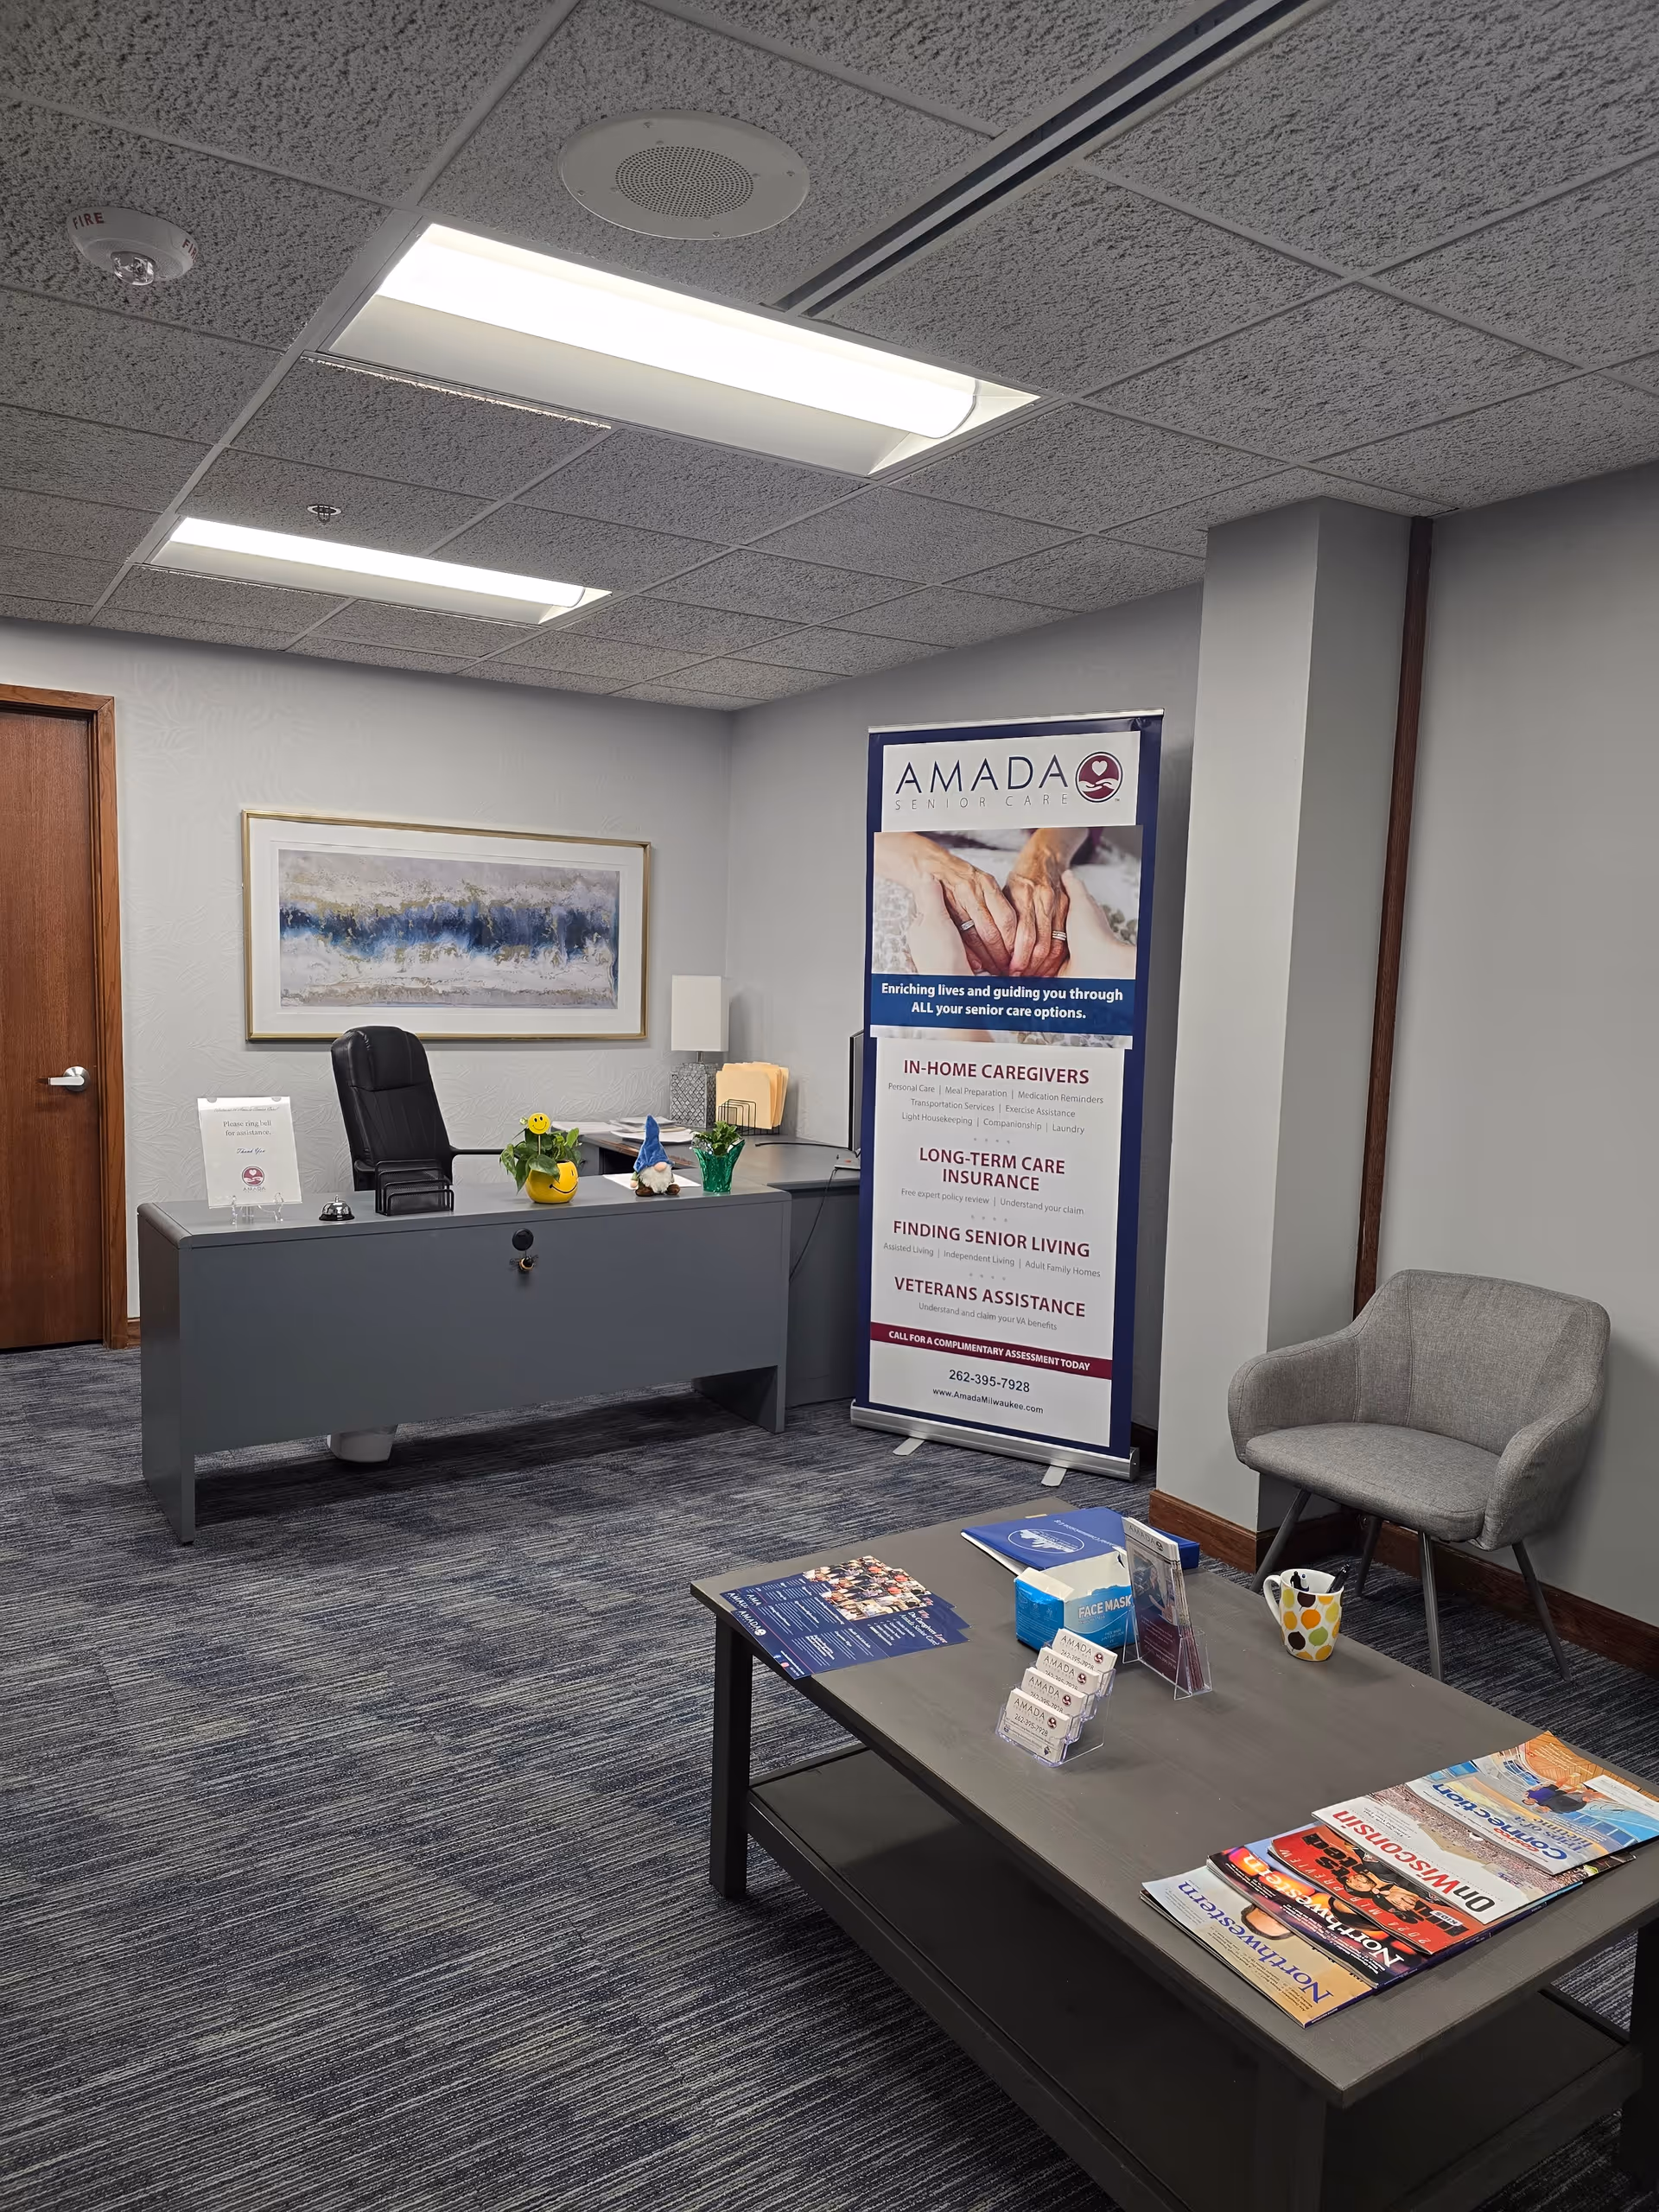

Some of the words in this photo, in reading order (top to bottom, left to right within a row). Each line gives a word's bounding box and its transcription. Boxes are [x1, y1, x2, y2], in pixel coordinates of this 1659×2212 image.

[73, 213, 105, 230] FIRE
[895, 754, 1068, 794] AMADA
[895, 796, 986, 810] SENIOR
[1005, 793, 1068, 807] CARE
[881, 982, 935, 999] Enriching
[938, 984, 964, 997] lives
[967, 984, 990, 998] and
[993, 985, 1039, 1001] guiding
[1043, 989, 1066, 1001] you
[1069, 987, 1123, 1002] through
[912, 1001, 933, 1014] ALL
[936, 1004, 963, 1016] your
[965, 1003, 1004, 1016] senior
[1006, 1006, 1032, 1017] care
[1034, 1005, 1086, 1020] options.
[904, 1059, 977, 1077] IN-HOME
[982, 1064, 1090, 1084] CAREGIVERS
[888, 1083, 918, 1092] Personal
[918, 1084, 935, 1093] Care
[945, 1086, 963, 1095] Meal
[964, 1087, 1007, 1099] Preparation
[1018, 1091, 1058, 1102] Medication
[1060, 1093, 1104, 1104] Reminders
[911, 1098, 963, 1111] Transportation
[964, 1102, 995, 1112] Services
[1005, 1104, 1035, 1115] Exercise
[1036, 1107, 1076, 1118] Assistance
[901, 1112, 920, 1122] Light
[921, 1114, 973, 1127] Housekeeping
[983, 1118, 1042, 1131] Companionship
[1052, 1124, 1085, 1135] Laundry
[919, 1147, 1017, 1169] LONG-TERM
[1021, 1156, 1065, 1174] CARE
[943, 1168, 1039, 1192] INSURANCE
[901, 1188, 916, 1197] Free
[918, 1190, 941, 1201] expert
[942, 1192, 963, 1204] policy
[964, 1194, 989, 1205] review
[1000, 1198, 1043, 1211] Understand
[1044, 1205, 1061, 1214] your
[1063, 1205, 1084, 1215] claim
[893, 1220, 961, 1242] FINDING
[964, 1229, 1027, 1249] SENIOR
[1031, 1236, 1090, 1258] LIVING
[883, 1242, 912, 1254] Assisted
[912, 1245, 934, 1257] Living
[944, 1249, 991, 1263] Independent
[992, 1255, 1015, 1267] Living
[1025, 1260, 1046, 1271] Adult
[1046, 1262, 1071, 1275] Family
[1072, 1266, 1101, 1278] Homes
[894, 1276, 977, 1300] VETERANS
[982, 1288, 1086, 1318] ASSISTANCE
[918, 1301, 960, 1316] Understand
[961, 1308, 976, 1318] and
[976, 1310, 996, 1321] claim
[997, 1314, 1015, 1325] your
[1016, 1316, 1027, 1325] VA
[1027, 1317, 1058, 1331] benefits
[888, 1331, 909, 1342] CALL
[910, 1334, 925, 1344] FOR
[933, 1338, 1004, 1357] COMPLIMENTARY
[1005, 1349, 1060, 1367] ASSESSMENT
[1060, 1358, 1090, 1371] TODAY
[949, 1369, 1030, 1393] 262-395-7928
[932, 1388, 1044, 1414] www.AmadaMilwaukee.com
[1128, 1525, 1156, 1545] AMADA
[738, 1611, 761, 1630] AMADA
[1078, 1602, 1103, 1618] FACE
[1061, 1635, 1092, 1656] AMADA
[1044, 1656, 1076, 1676] AMADA
[1028, 1676, 1060, 1698] AMADA
[1014, 1698, 1046, 1720] AMADA
[1014, 1713, 1049, 1737] 262-395-7928
[1432, 1783, 1568, 1860] Connection
[1520, 1822, 1542, 1831] of
[1534, 1818, 1593, 1847] lifetime
[1543, 1831, 1582, 1851] Trips
[1280, 1848, 1344, 1892] PREVIEW
[1243, 1854, 1405, 1968] Northwestern
[1350, 1896, 1382, 1916] MLB
[1435, 1910, 1459, 1926] KIDS
[1178, 1880, 1334, 2004] Northwestern
[1387, 1921, 1431, 1944] 2024
